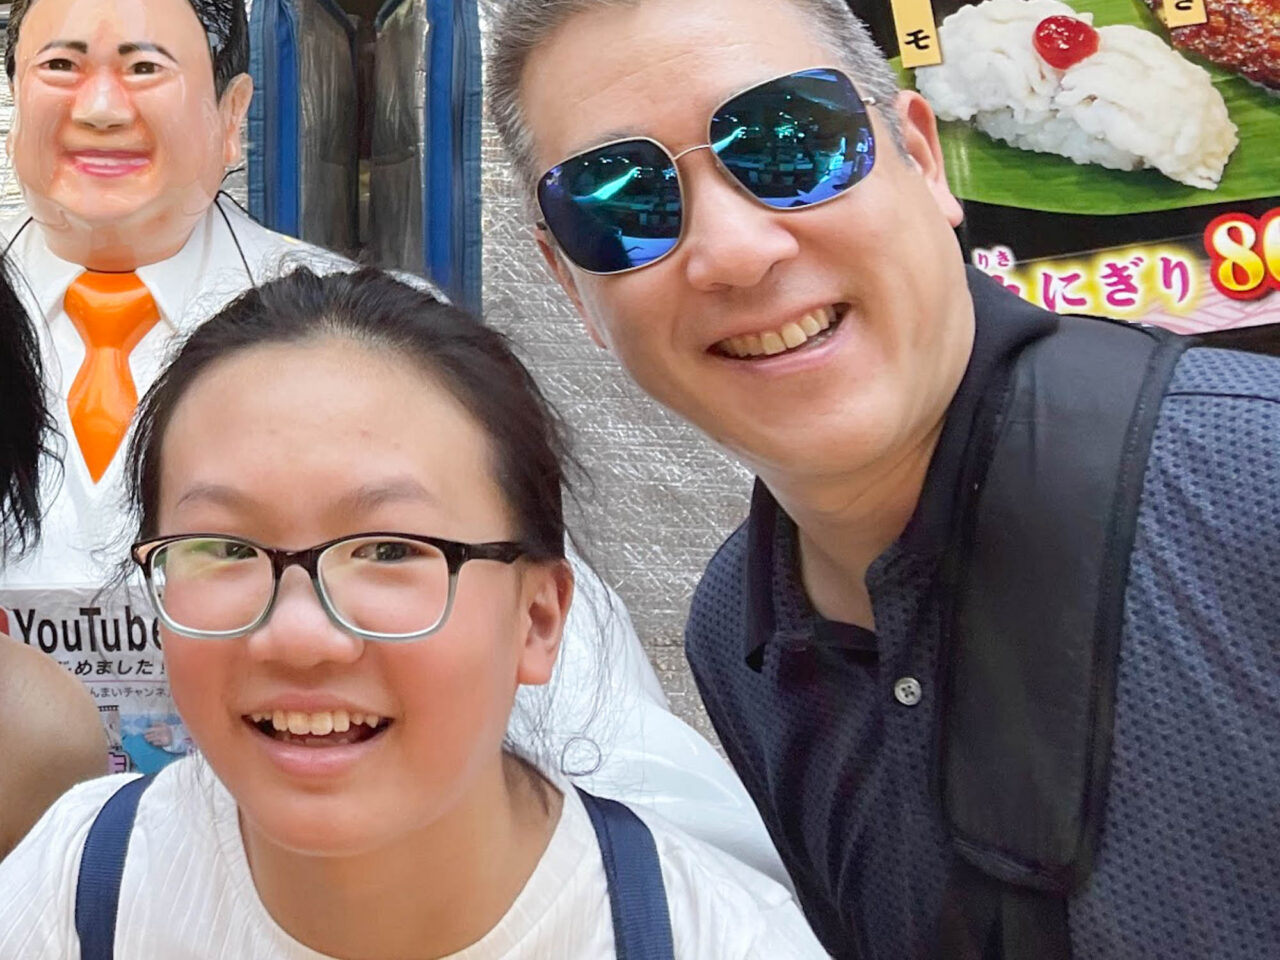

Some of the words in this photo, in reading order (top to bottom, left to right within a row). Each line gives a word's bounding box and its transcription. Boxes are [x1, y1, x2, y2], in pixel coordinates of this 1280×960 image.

[990, 256, 1190, 312] にぎり
[90, 686, 171, 699] んまいチャンネ
